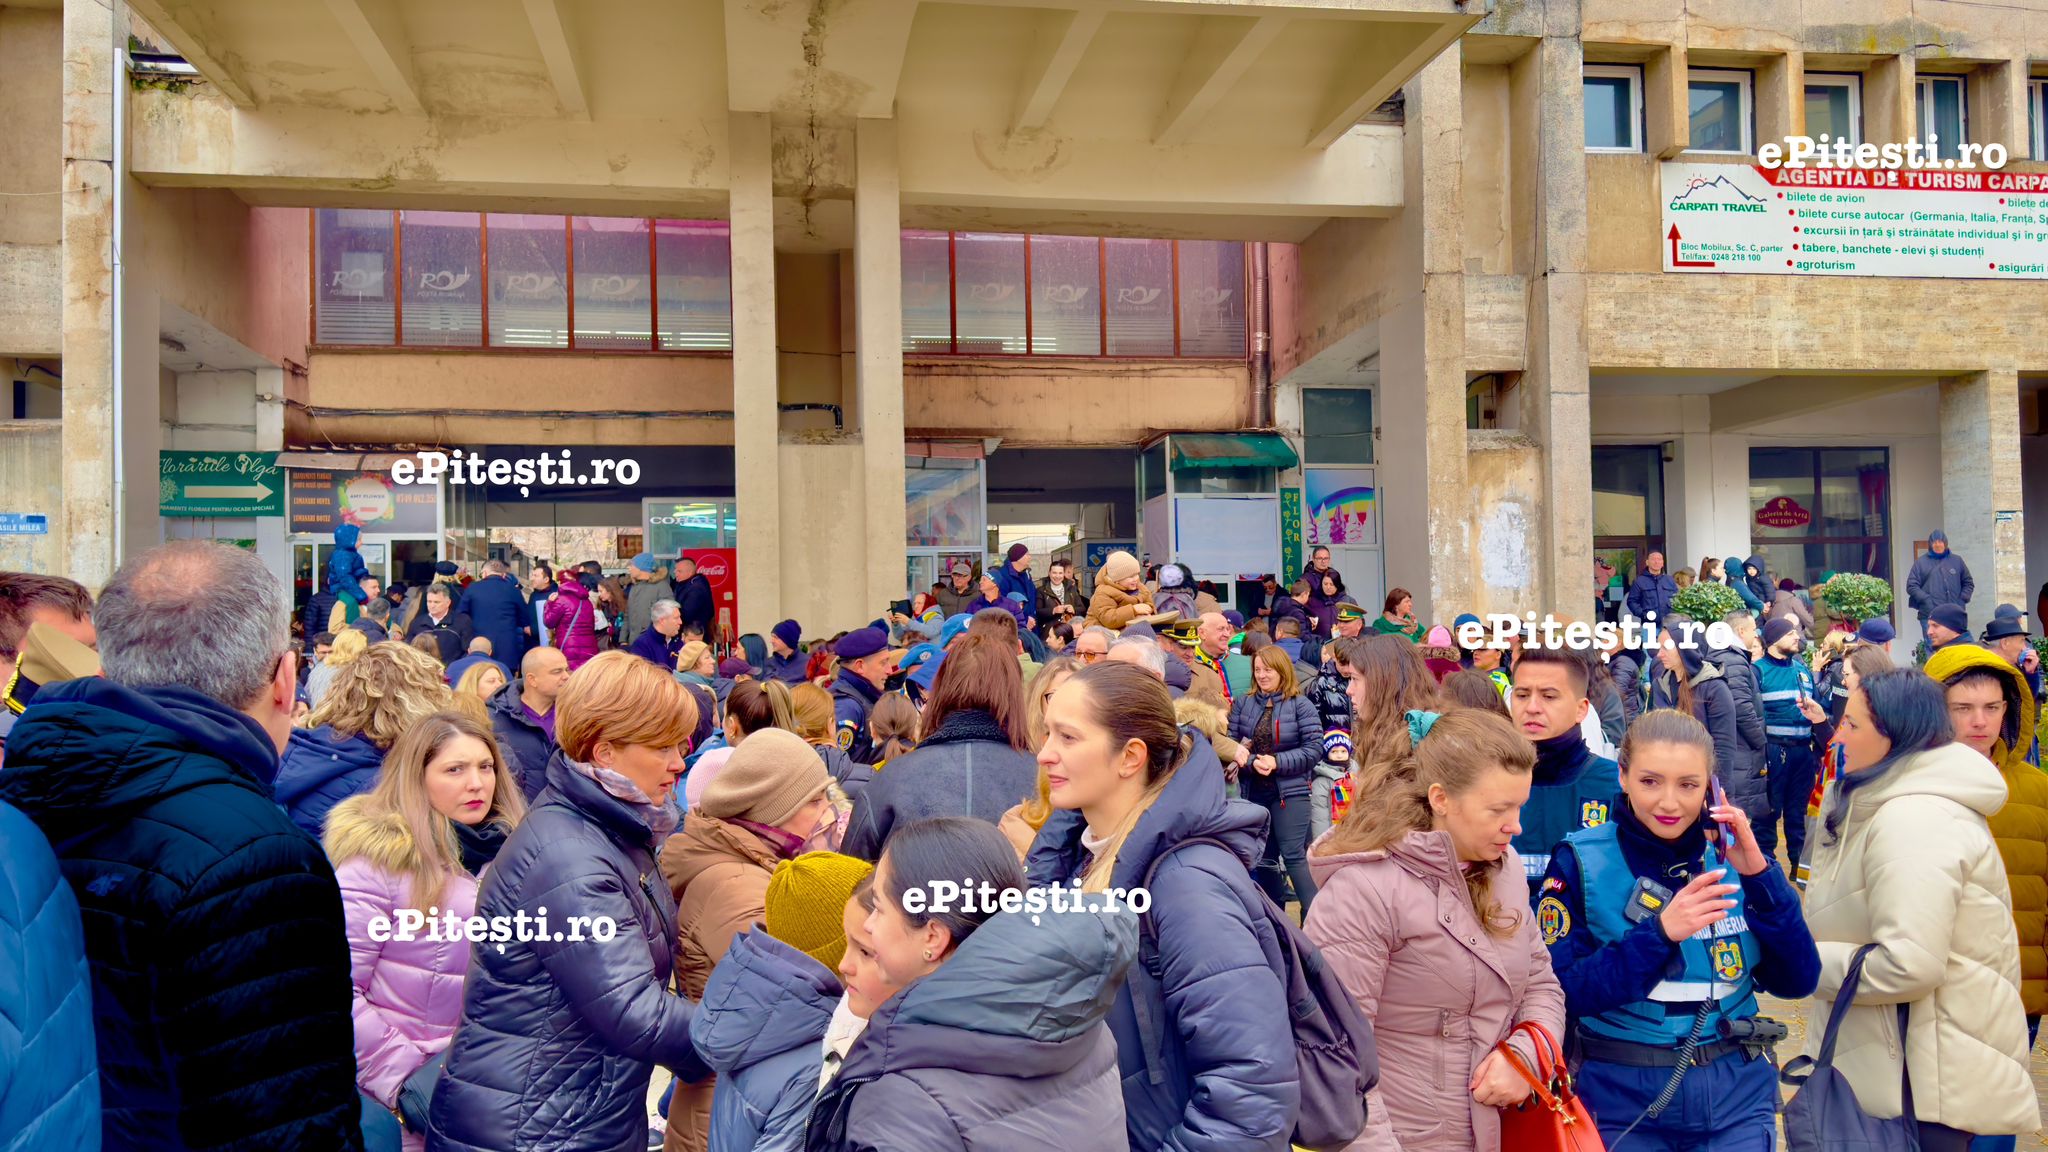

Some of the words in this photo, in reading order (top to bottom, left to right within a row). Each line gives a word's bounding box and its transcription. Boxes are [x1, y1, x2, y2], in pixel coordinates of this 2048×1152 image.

[1775, 169, 1868, 187] AGENTIA
[1875, 171, 1899, 187] DE
[1907, 173, 1982, 189] TURISM
[1786, 191, 1817, 202] bilete
[1819, 192, 1833, 202] de
[1836, 193, 1865, 203] avion
[2008, 197, 2036, 208] bilete
[1669, 202, 1719, 212] CARPATI
[1722, 203, 1767, 213] TRAVEL
[1798, 208, 1828, 219] bilete
[1831, 211, 1861, 220] curse
[1864, 211, 1904, 220] autocar
[1910, 211, 1967, 223] (Germania,
[1970, 212, 1999, 224] Italia,
[1803, 226, 1847, 236] excursii
[1957, 229, 2009, 240] individual
[1681, 243, 1699, 251] Bloc
[1760, 245, 1783, 254] parter
[1802, 243, 1839, 254] tabere,
[1842, 244, 1892, 254] banchete
[1901, 245, 1926, 255] elevi
[1748, 254, 1761, 262] 100
[1796, 260, 1856, 270] agroturism
